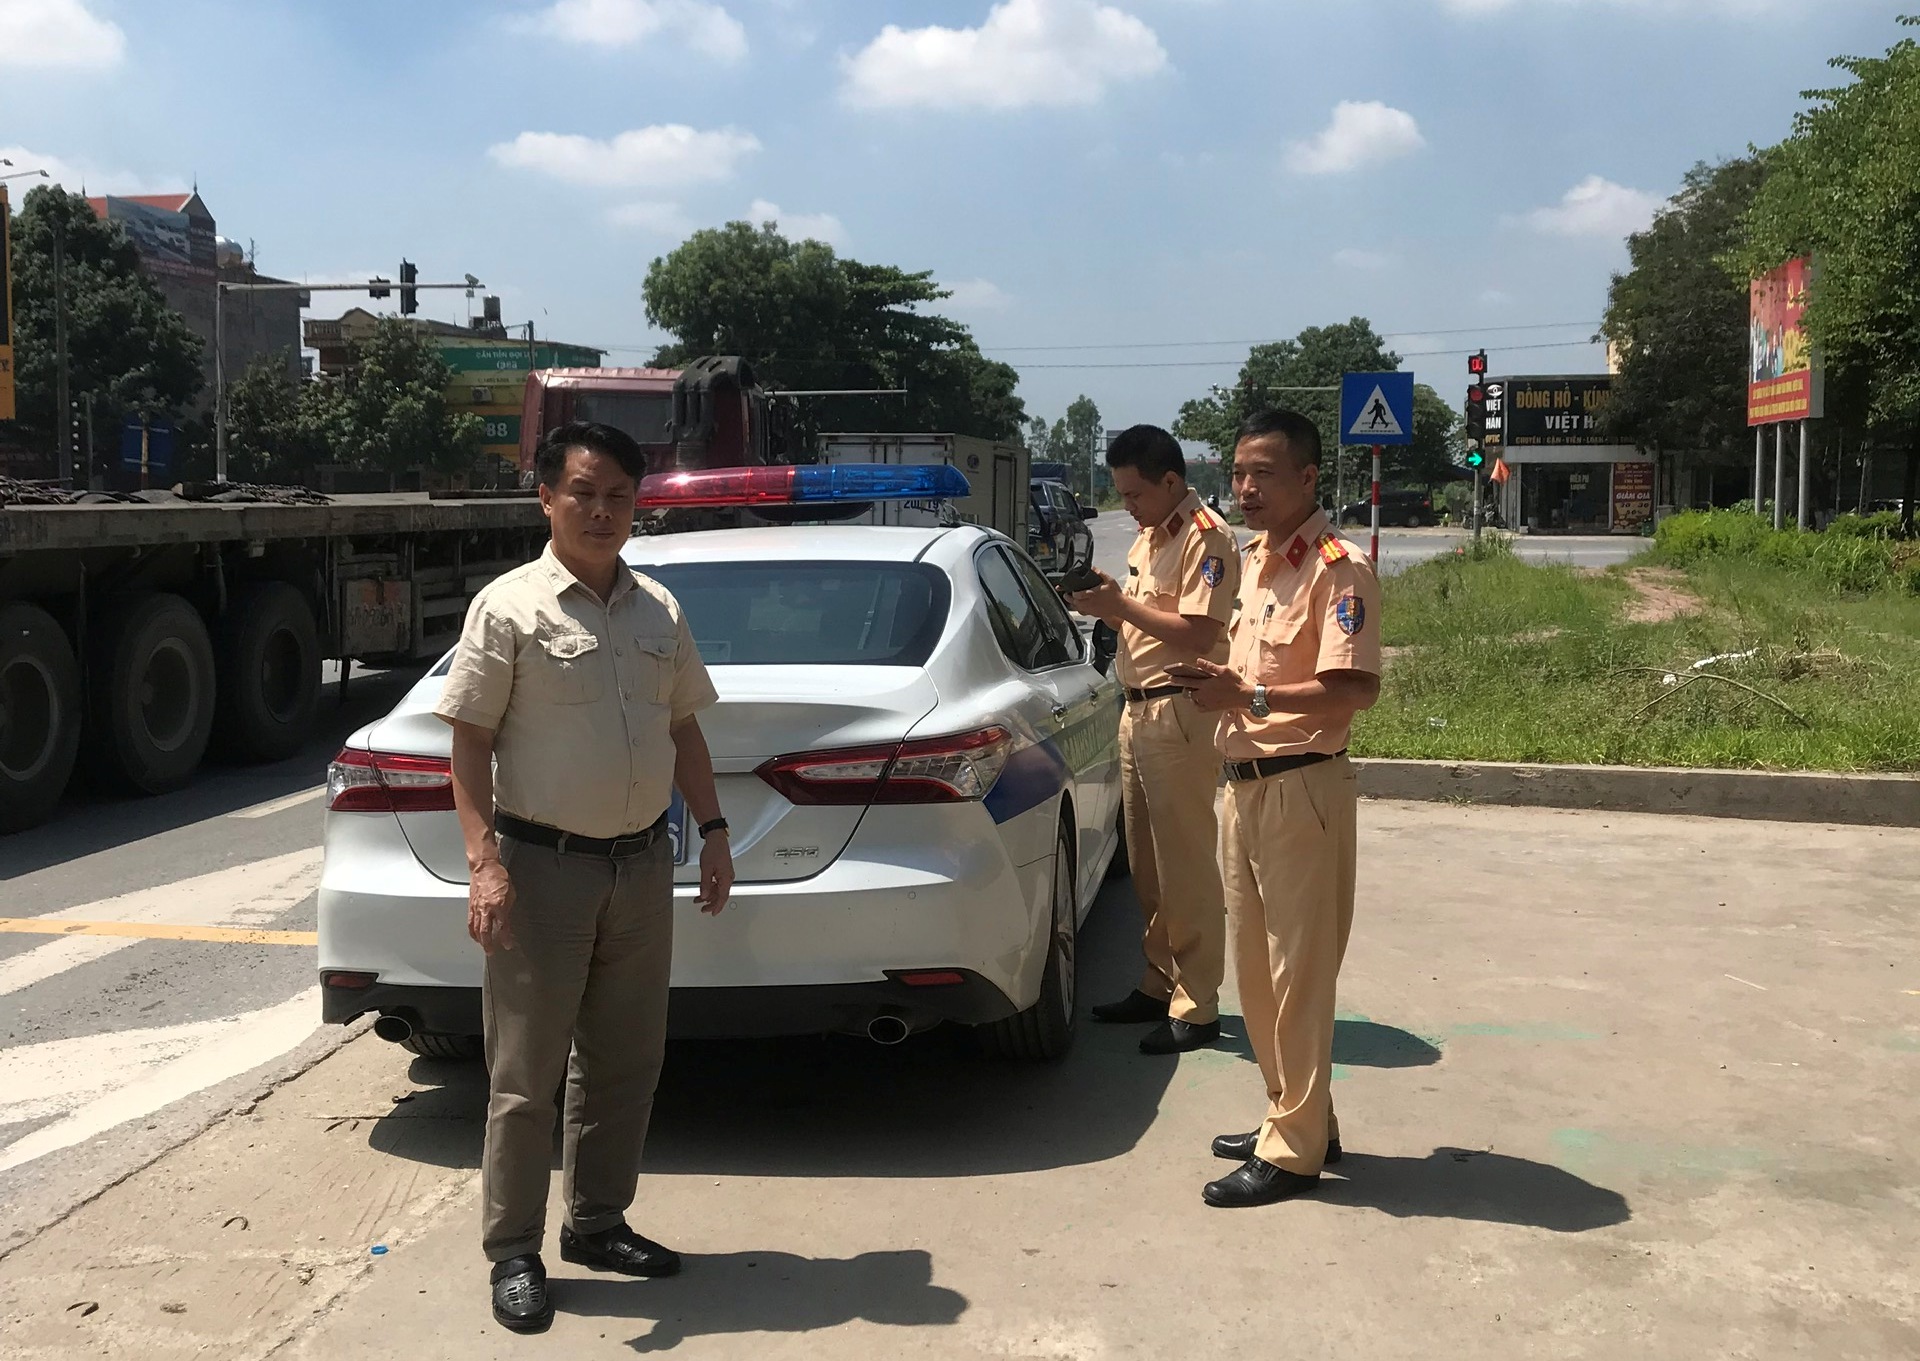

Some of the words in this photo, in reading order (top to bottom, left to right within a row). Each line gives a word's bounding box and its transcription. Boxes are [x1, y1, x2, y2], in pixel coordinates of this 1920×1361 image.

[1516, 382, 1551, 409] ĐỒNG
[1554, 382, 1572, 408] HỒ
[1545, 411, 1580, 433] VIỆT
